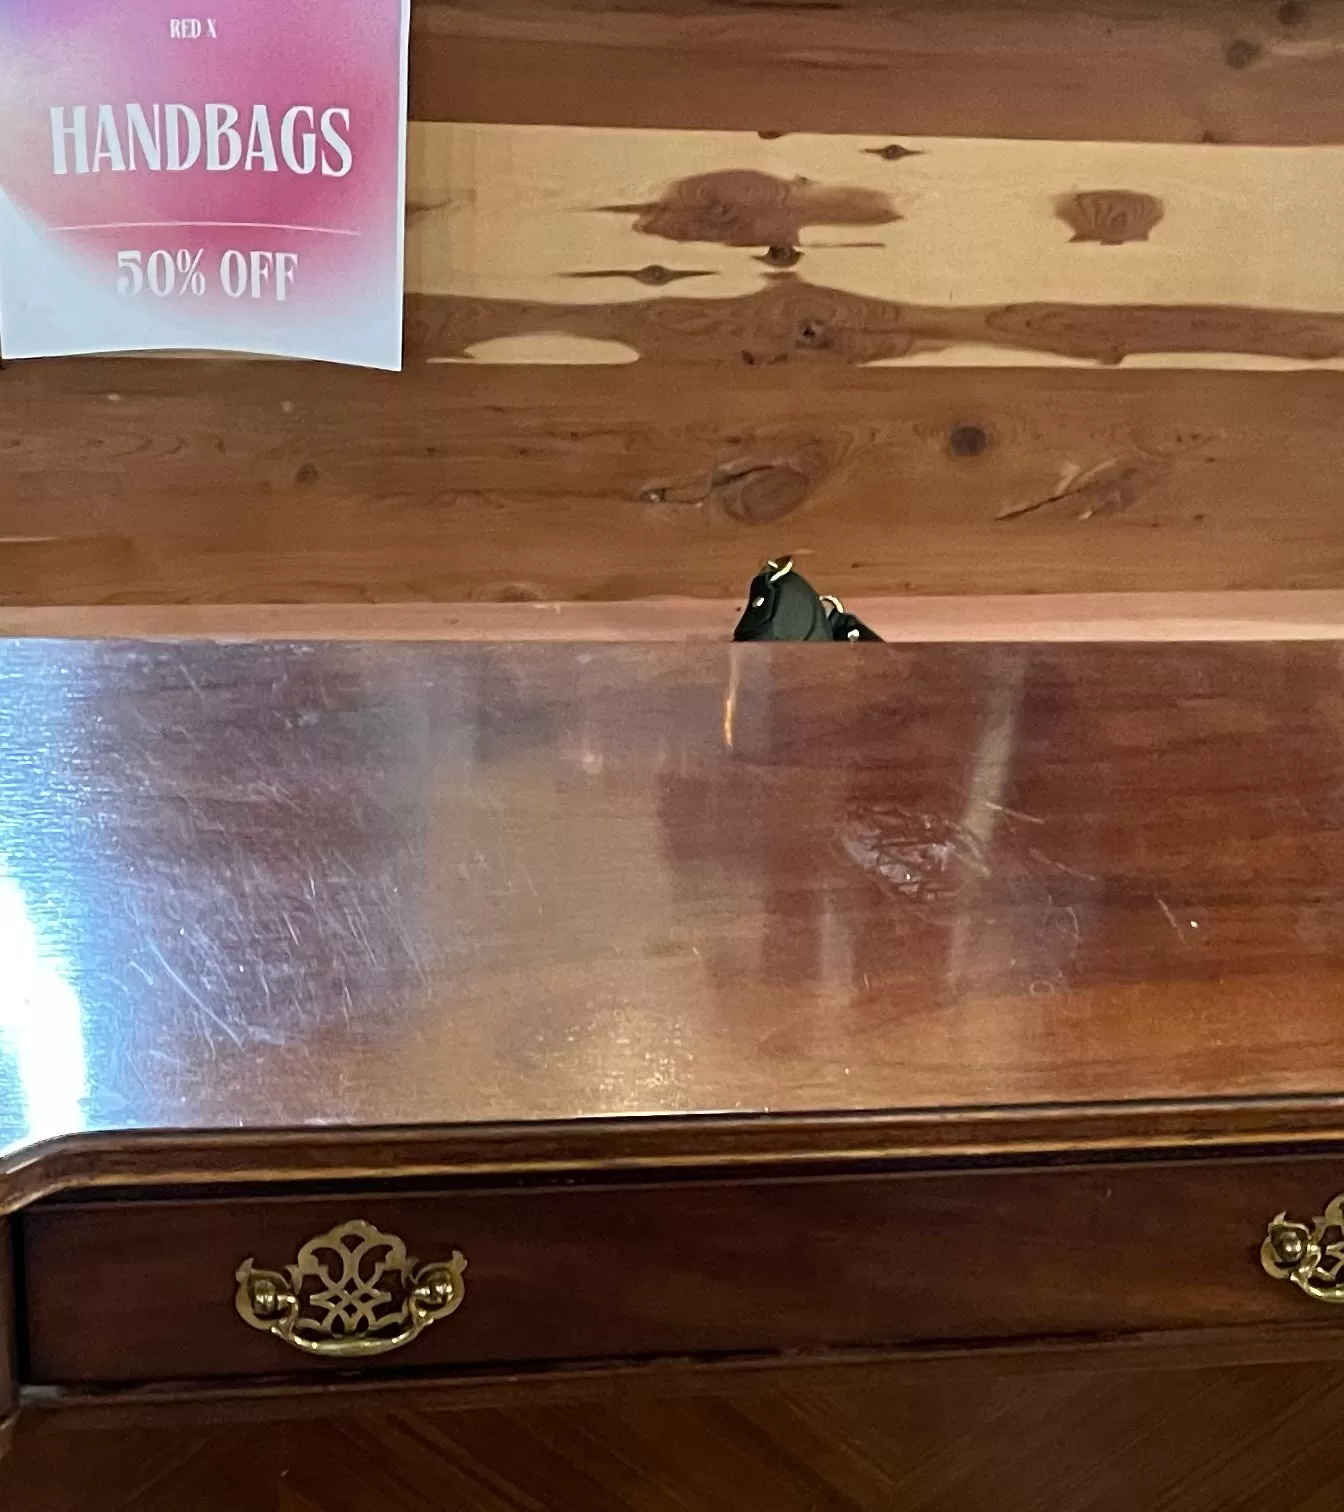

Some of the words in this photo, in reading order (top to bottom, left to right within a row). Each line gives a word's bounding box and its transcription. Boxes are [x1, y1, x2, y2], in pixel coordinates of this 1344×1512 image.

[169, 18, 202, 39] RED
[206, 18, 217, 38] X
[49, 102, 354, 178] HANDBAGS
[116, 247, 206, 298] 50%
[218, 249, 299, 301] OFF
